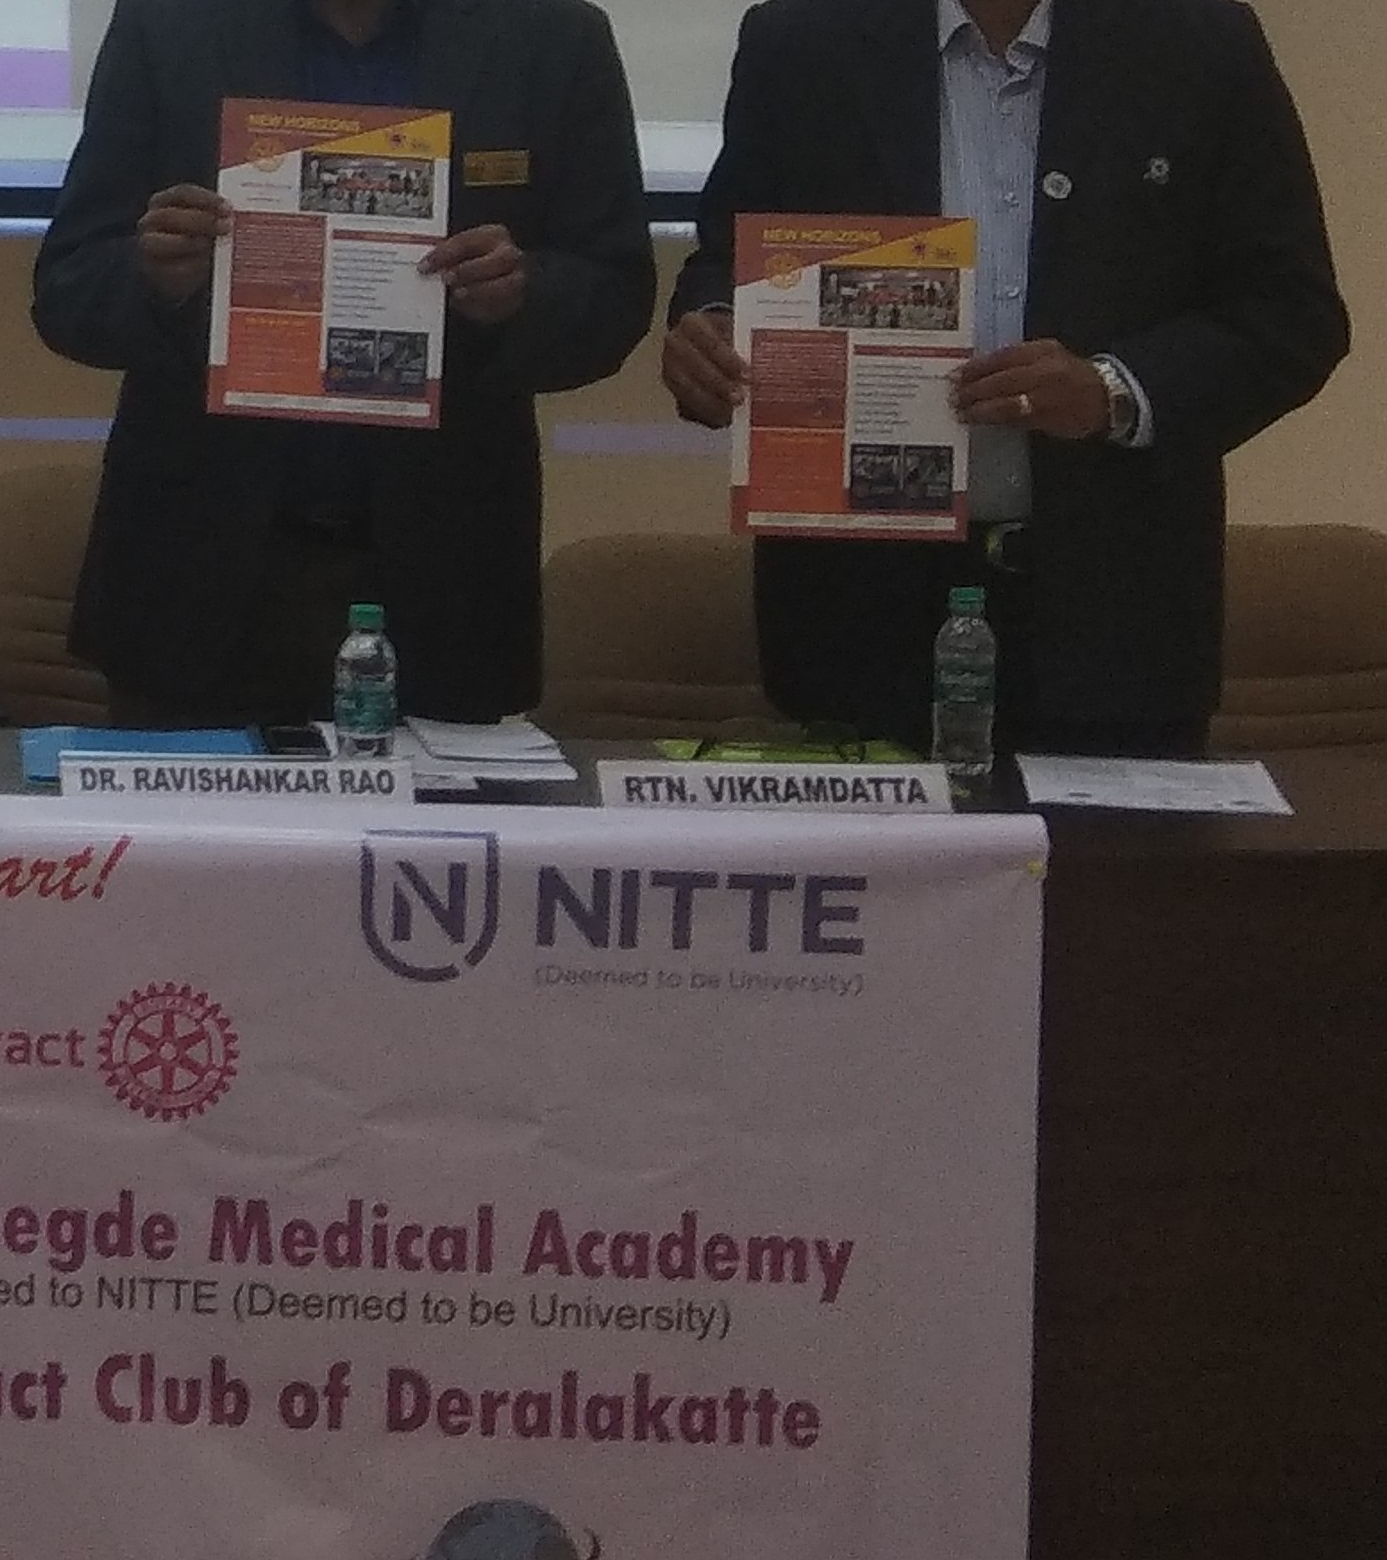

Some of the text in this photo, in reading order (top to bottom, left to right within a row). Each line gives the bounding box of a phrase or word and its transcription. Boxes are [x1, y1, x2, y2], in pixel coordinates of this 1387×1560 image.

[79, 766, 397, 796] DR. RAVISHANKAR RAO
[626, 773, 928, 806] RTN. VIKRAMDATTA
[535, 866, 869, 955] NITTE
[534, 962, 865, 998] (Deemed to be University)
[208, 1195, 494, 1276] Medical
[523, 1209, 857, 1303] Academy
[48, 1272, 84, 1310] to
[96, 1276, 220, 1317] NITTE
[232, 1282, 408, 1324] (Deemed
[421, 1290, 458, 1327] to
[468, 1289, 518, 1328] be
[529, 1292, 732, 1342] University)
[93, 1352, 250, 1428] Club
[277, 1359, 354, 1430] of
[385, 1365, 821, 1449] Deralakatte
